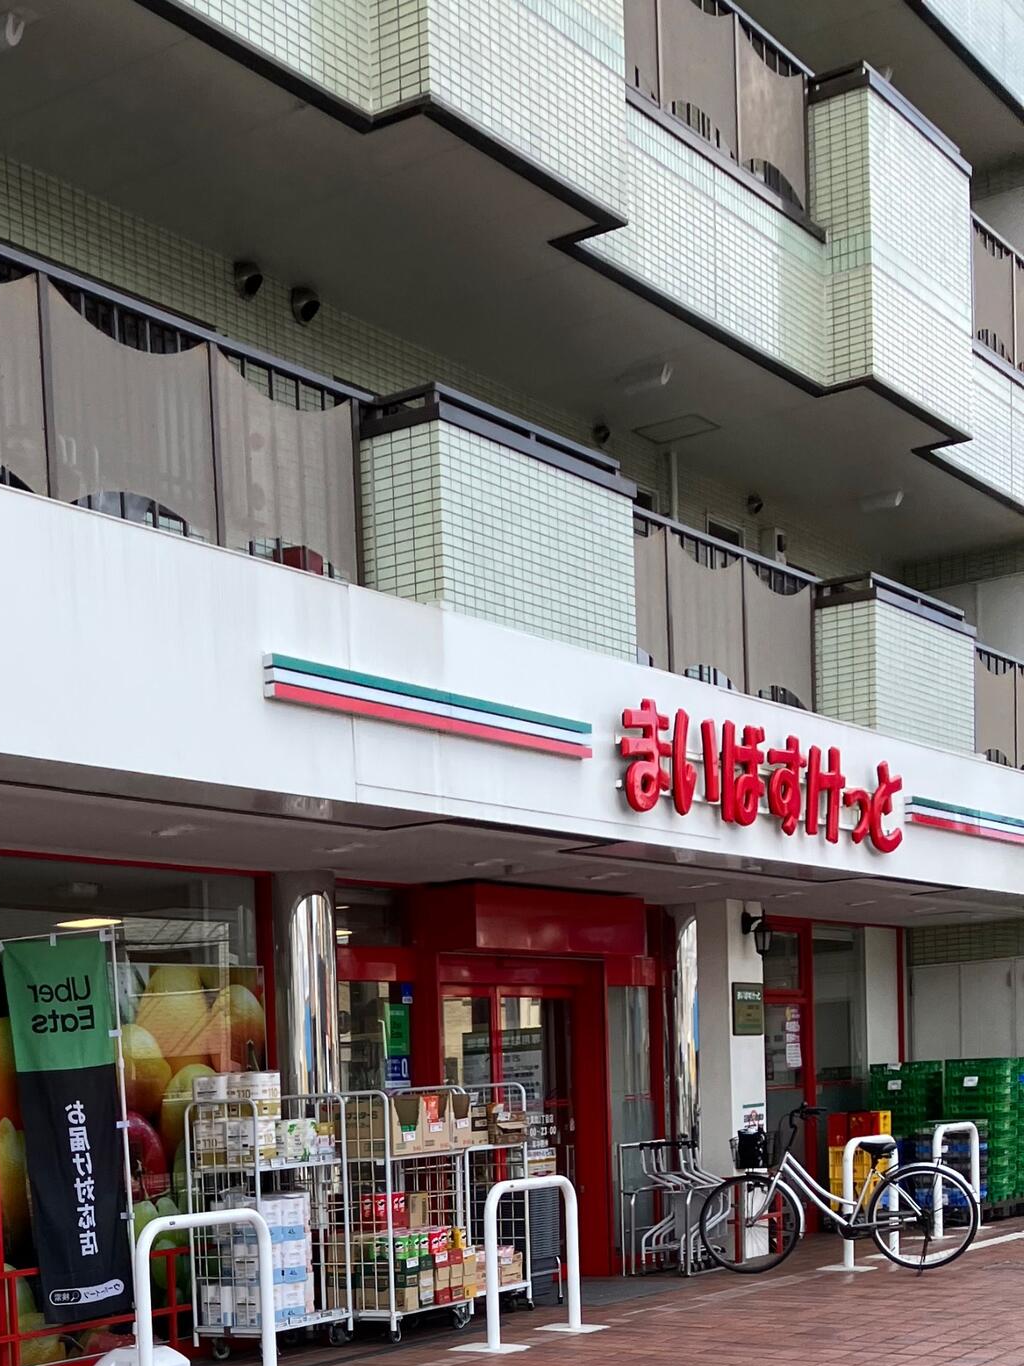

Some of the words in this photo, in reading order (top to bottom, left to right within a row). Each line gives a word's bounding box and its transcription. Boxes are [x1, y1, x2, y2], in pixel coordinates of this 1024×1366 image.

[621, 699, 903, 853] まいばすけっと
